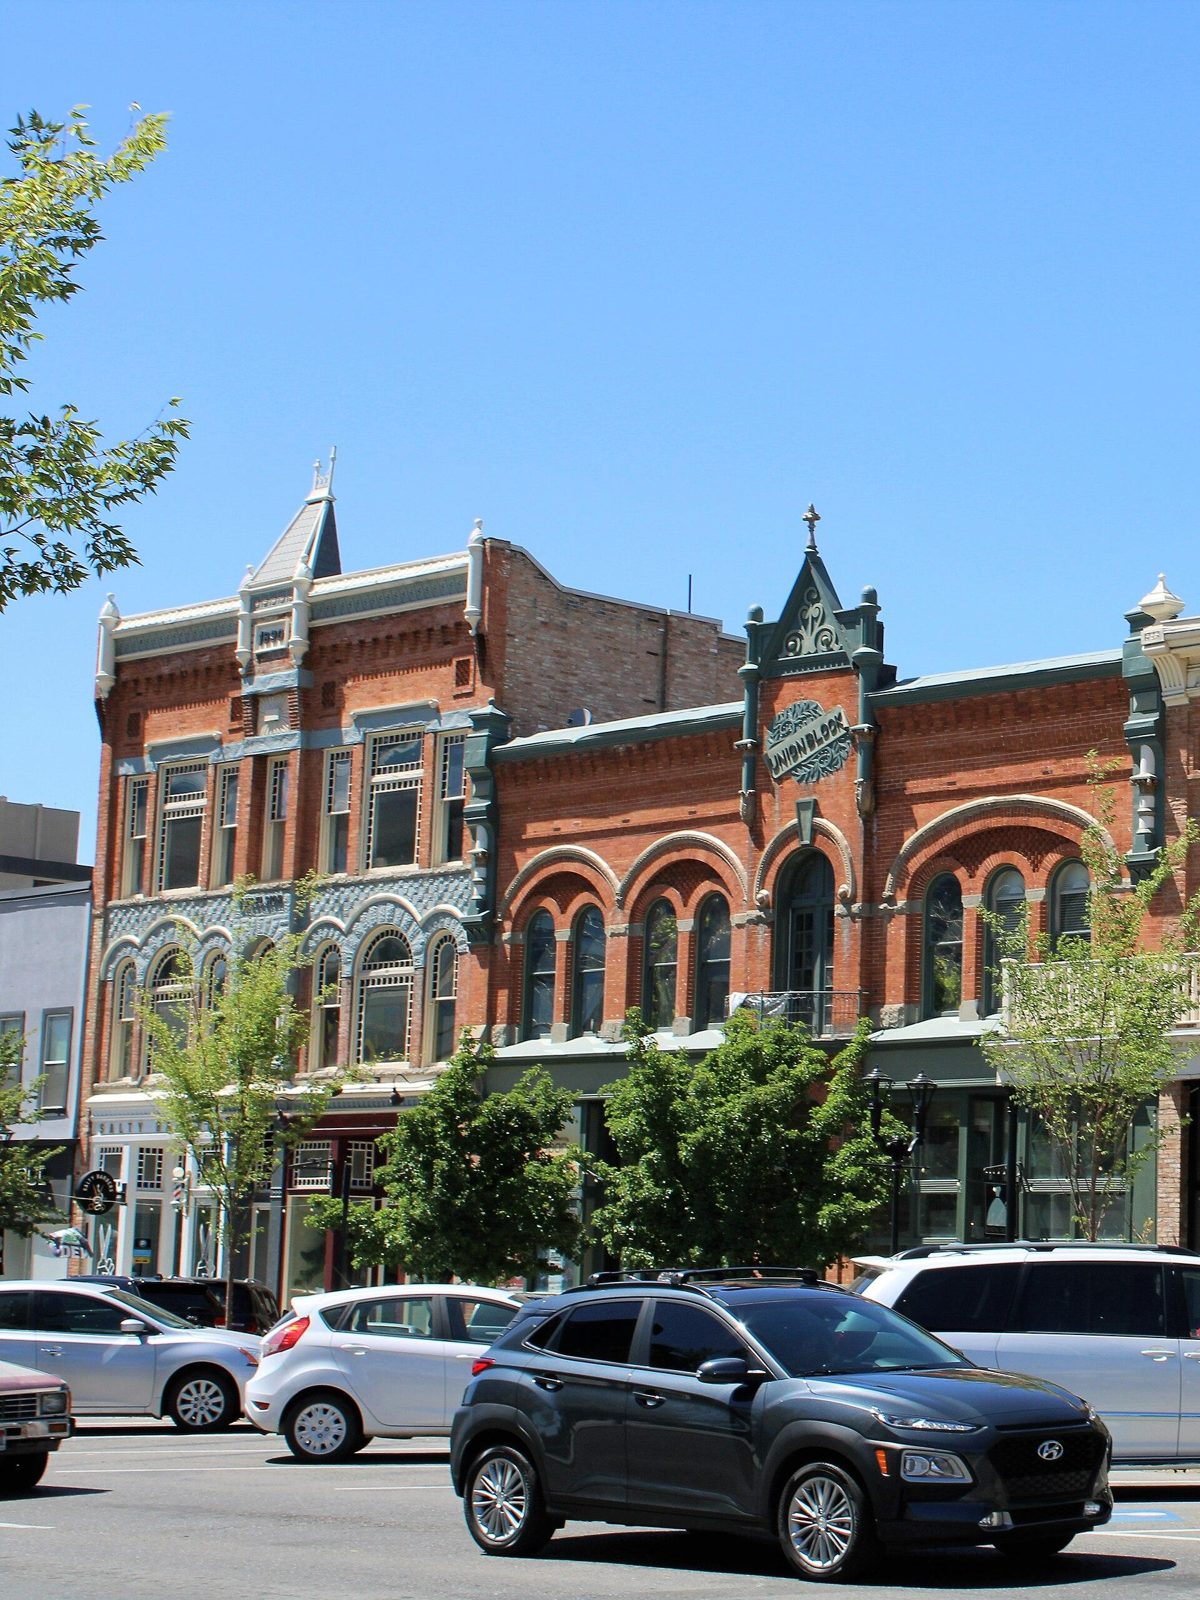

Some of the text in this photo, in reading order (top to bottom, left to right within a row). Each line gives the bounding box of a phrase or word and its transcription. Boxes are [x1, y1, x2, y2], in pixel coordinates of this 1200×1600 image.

[769, 712, 843, 775] UNION BLOCK
[100, 1122, 143, 1135] SALTY
